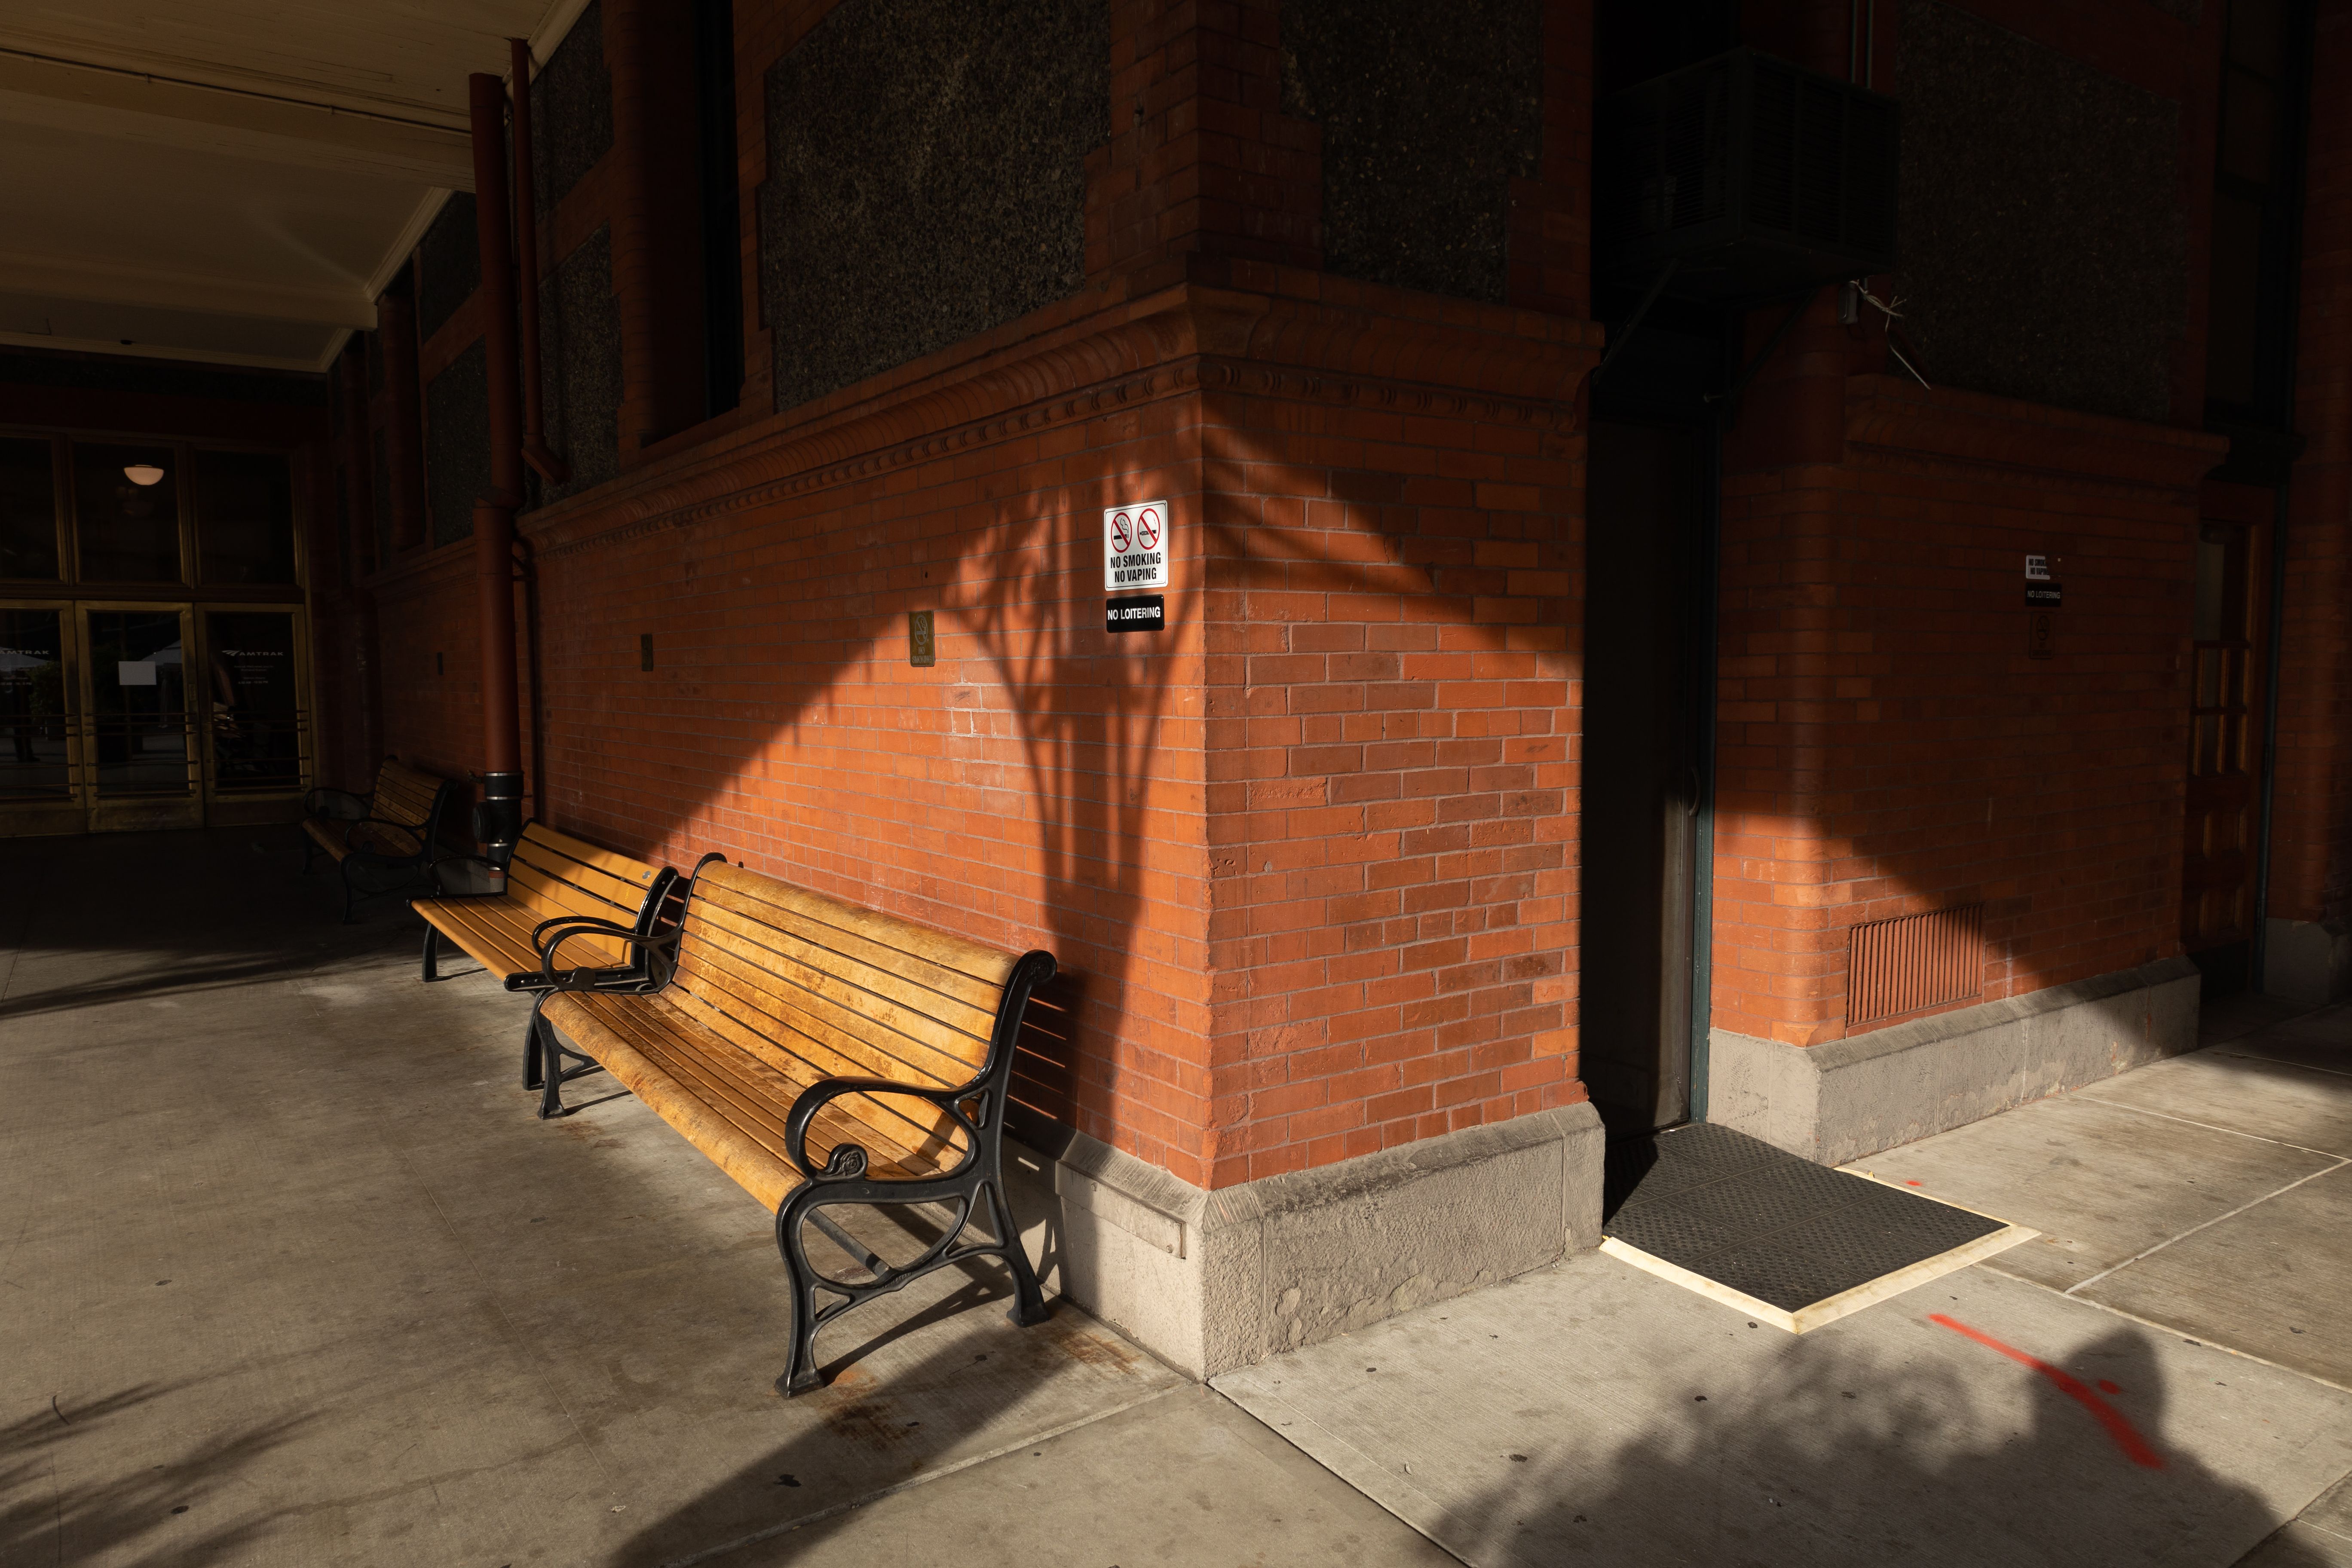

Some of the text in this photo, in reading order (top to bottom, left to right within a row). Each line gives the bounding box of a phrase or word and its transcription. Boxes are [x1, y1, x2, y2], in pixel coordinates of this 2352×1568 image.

[1110, 552, 1161, 569] NO SMOKING
[1115, 567, 1156, 582] NO VAPING
[2036, 591, 2061, 599] LOITERING
[1108, 606, 1161, 620] NO LOITERING
